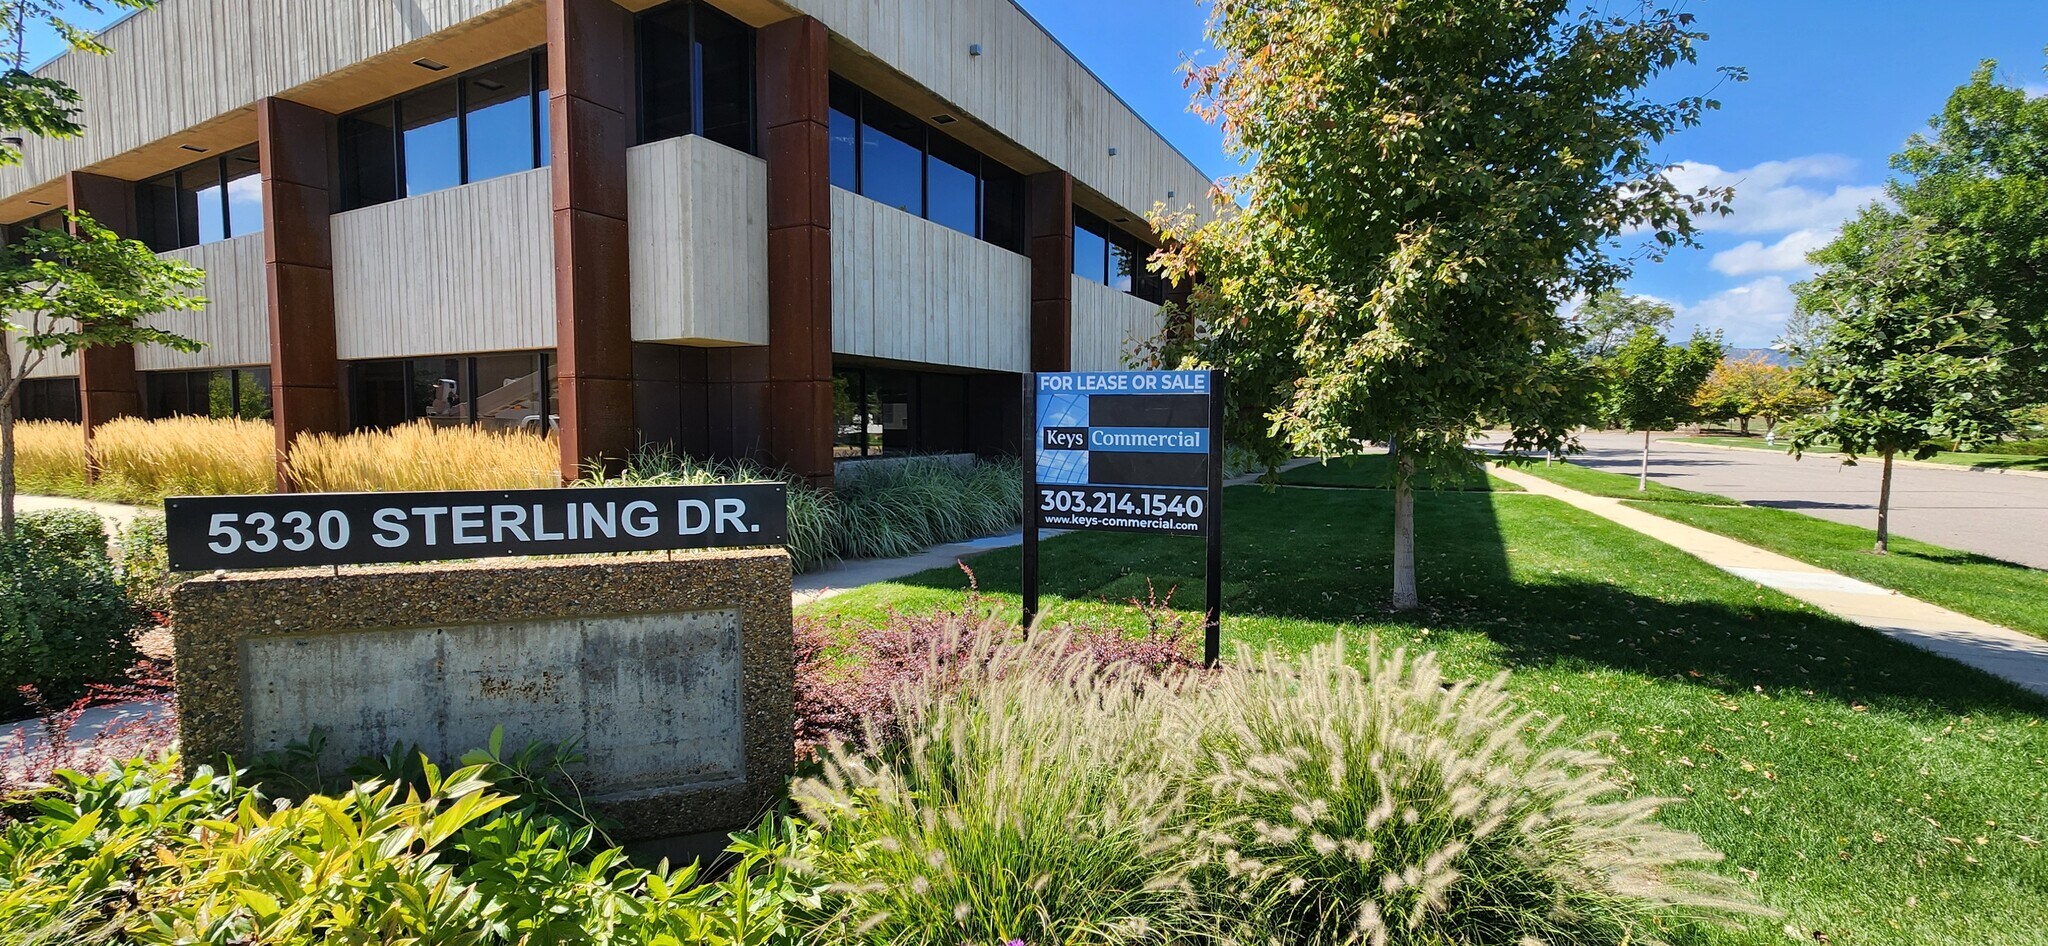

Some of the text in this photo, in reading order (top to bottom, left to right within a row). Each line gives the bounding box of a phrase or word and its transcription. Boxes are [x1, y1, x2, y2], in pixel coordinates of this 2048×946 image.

[1040, 374, 1205, 390] FOR LEASE OR SALE
[1046, 429, 1200, 448] Keys Commercial
[1040, 490, 1203, 518] 303.214.1540
[207, 498, 760, 555] 5330 STERLING DR.
[1045, 514, 1198, 531] www.keys-commercial.com
